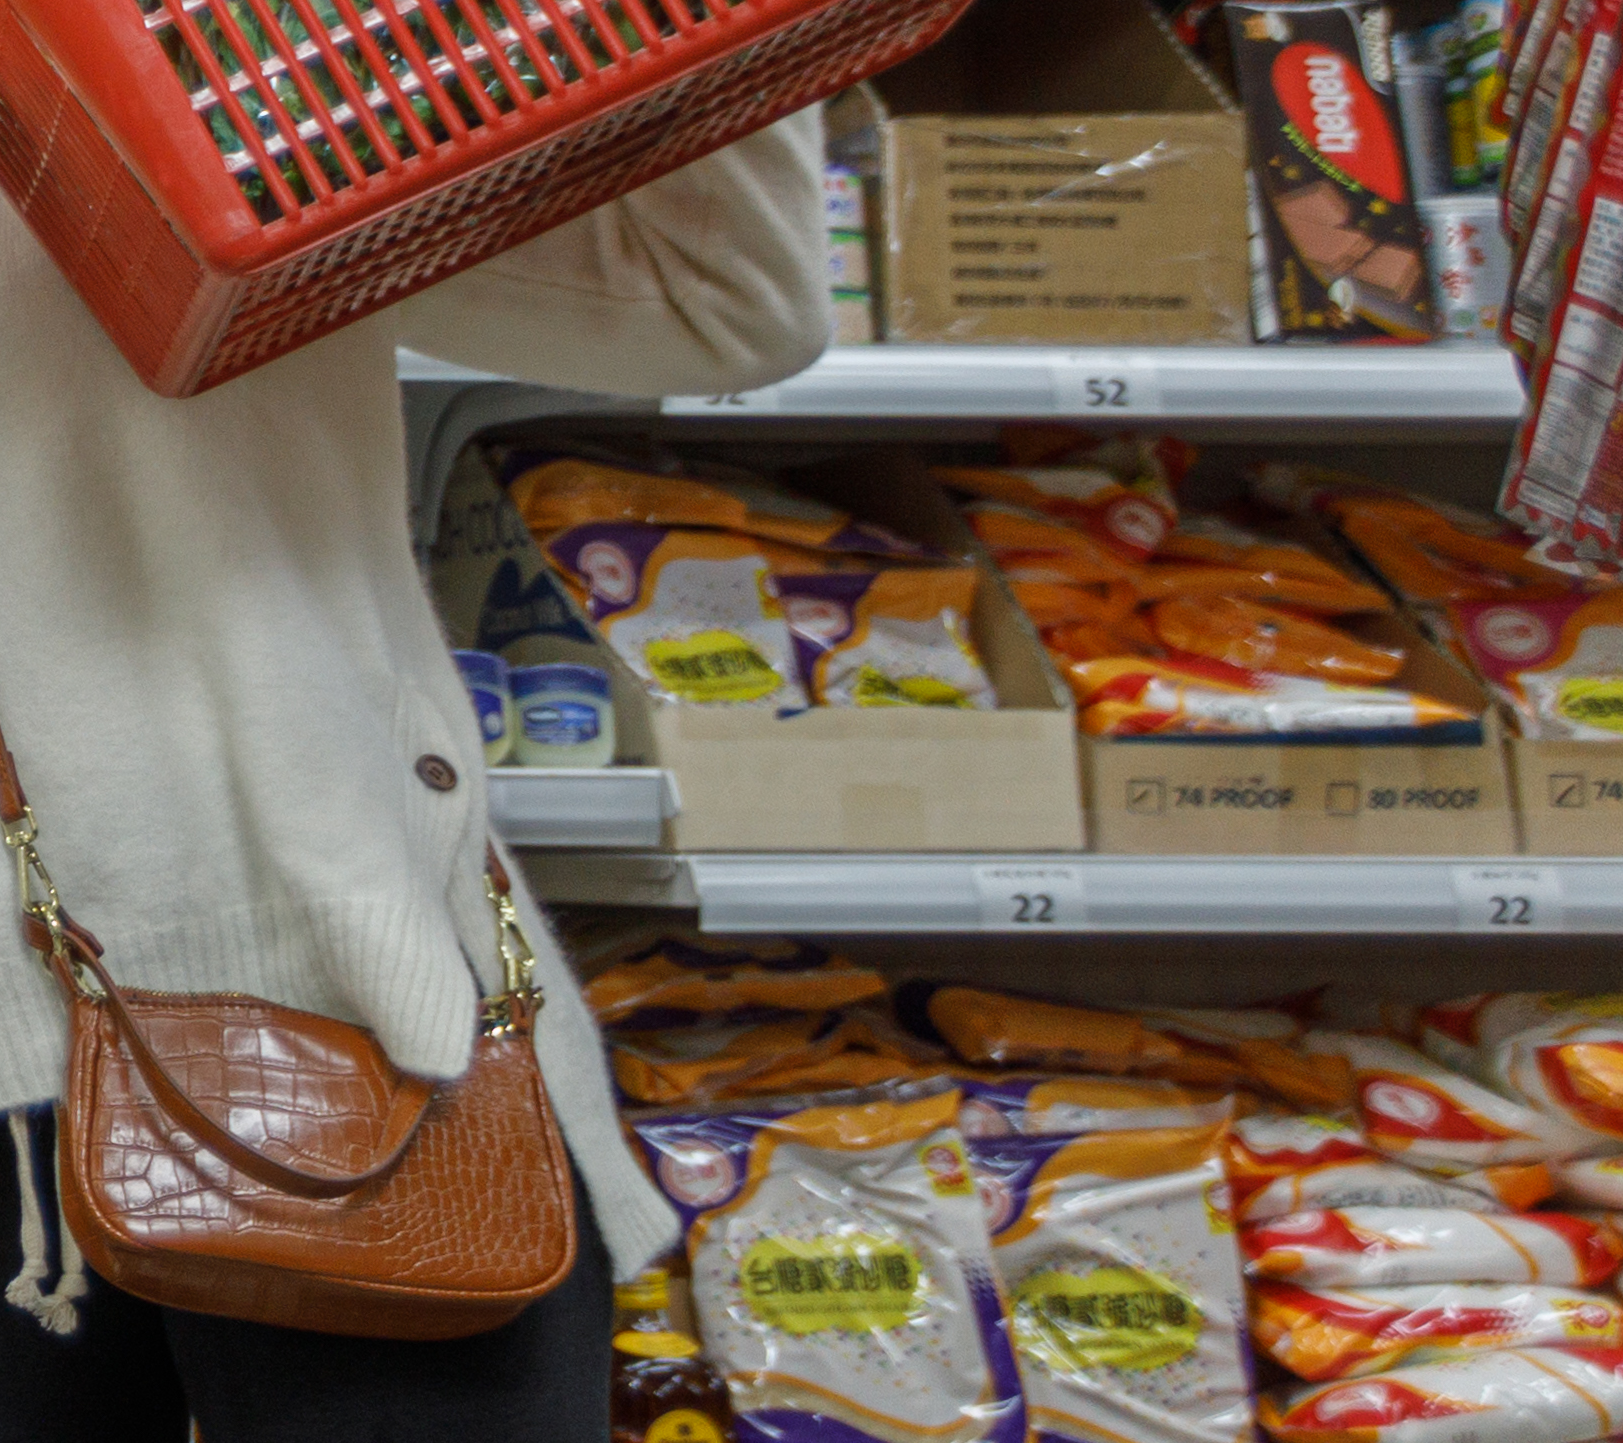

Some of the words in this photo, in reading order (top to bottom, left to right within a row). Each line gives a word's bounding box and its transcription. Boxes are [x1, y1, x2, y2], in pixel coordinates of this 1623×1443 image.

[1084, 380, 1128, 408] 52
[1209, 785, 1294, 809] PROOF
[1404, 788, 1480, 810] PROOF
[1011, 893, 1054, 924] 22
[1488, 896, 1532, 926] 22
